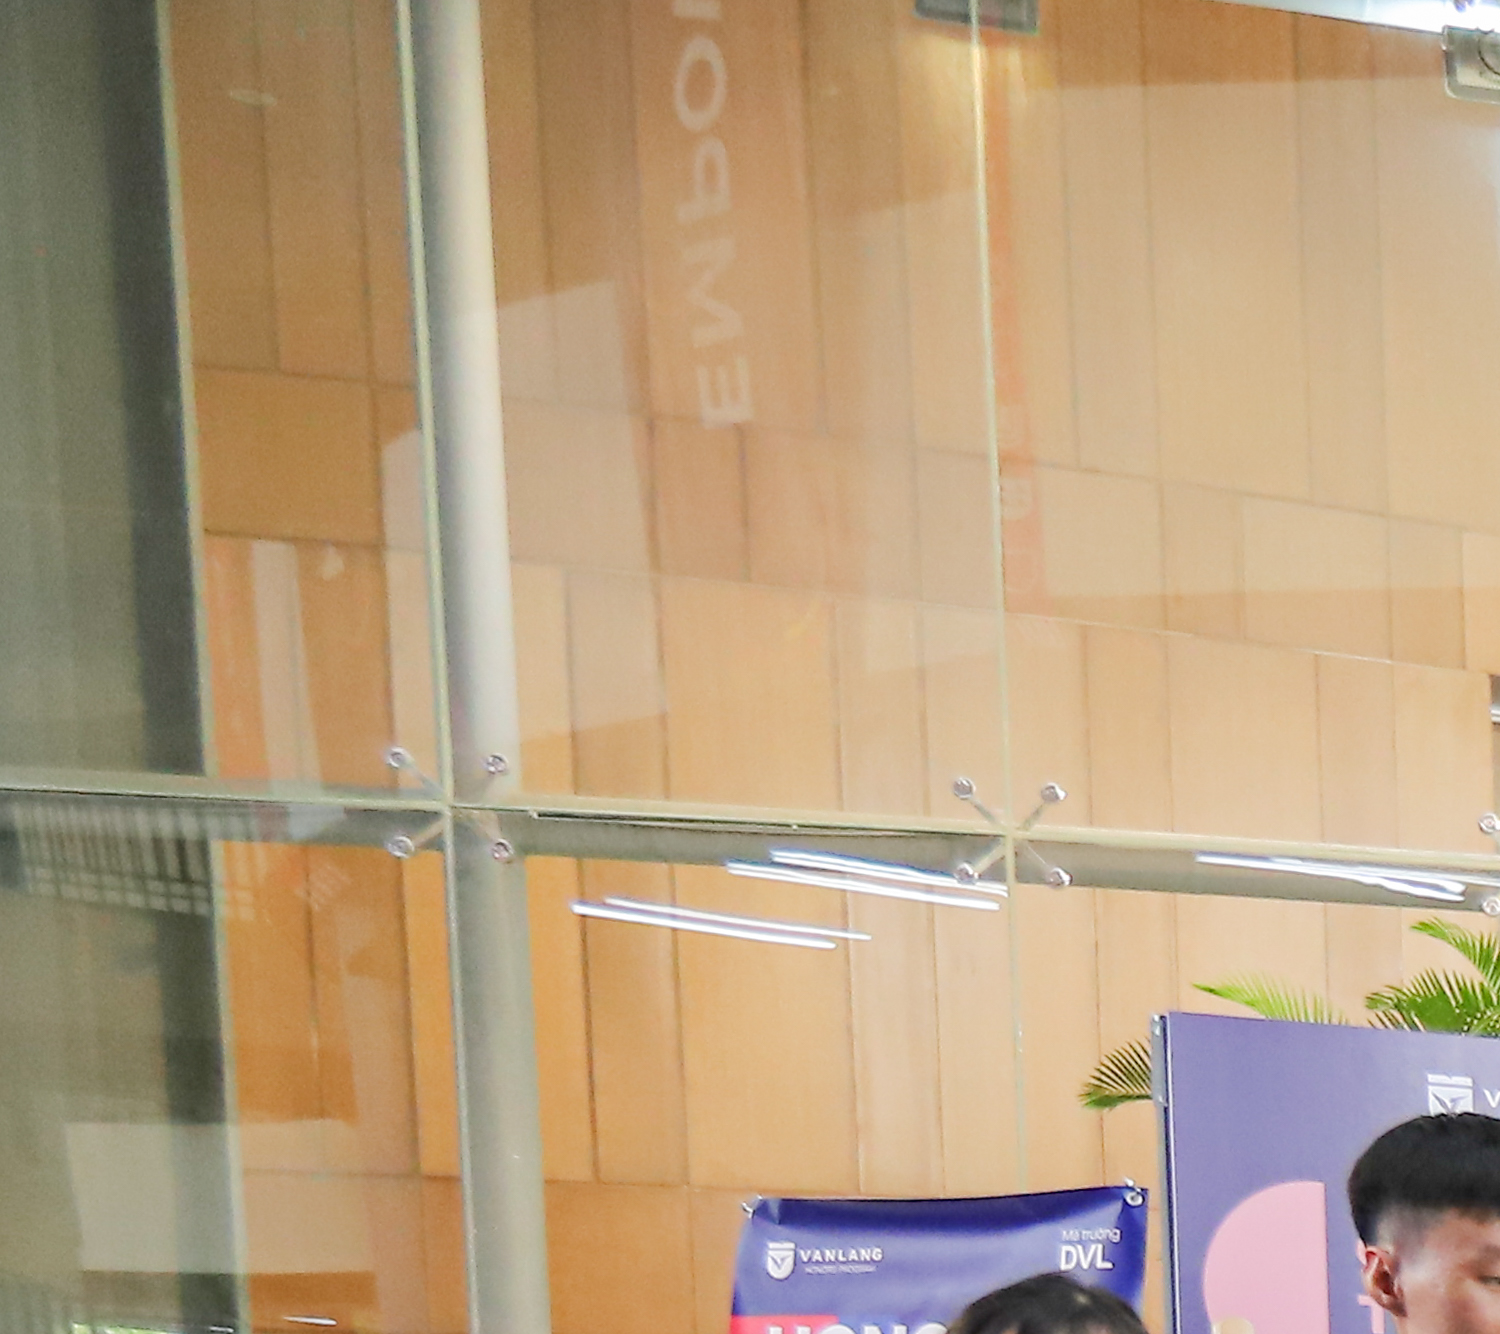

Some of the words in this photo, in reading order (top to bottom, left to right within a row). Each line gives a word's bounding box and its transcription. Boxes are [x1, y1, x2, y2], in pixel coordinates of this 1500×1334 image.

[800, 1247, 883, 1263] VANLANG
[1081, 1227, 1121, 1244] trường
[1060, 1243, 1114, 1272] DVL
